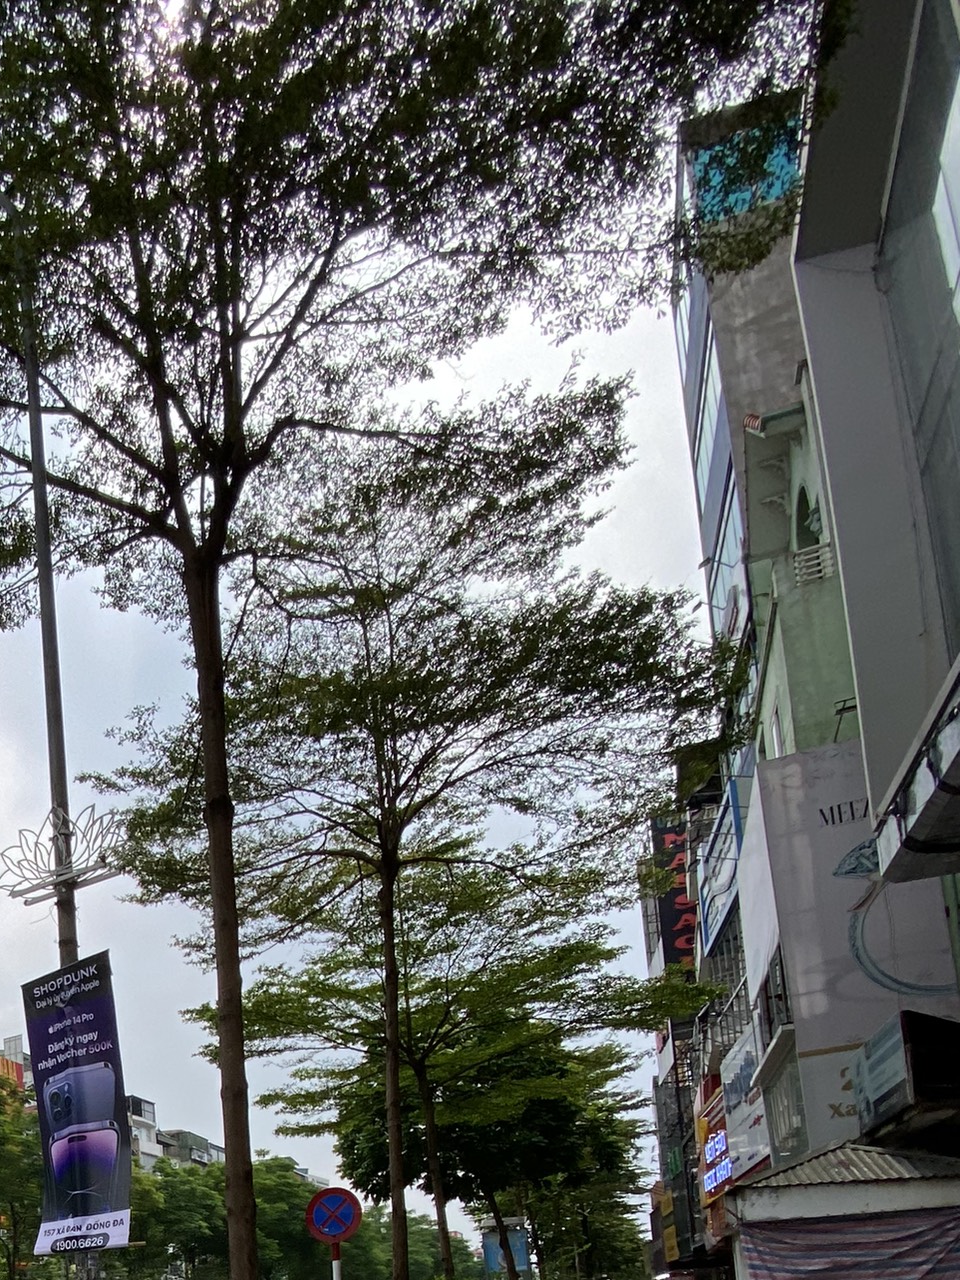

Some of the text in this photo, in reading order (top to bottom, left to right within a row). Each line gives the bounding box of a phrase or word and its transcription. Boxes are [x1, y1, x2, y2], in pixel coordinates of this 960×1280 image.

[33, 964, 98, 998] SHOPDUNK
[81, 979, 100, 992] Apple
[73, 1015, 81, 1025] 14
[82, 1013, 94, 1021] Pro
[76, 1031, 98, 1044] ngay
[57, 1046, 87, 1063] Voucher
[89, 1040, 113, 1054] 500K
[43, 1229, 56, 1237] 157
[56, 1236, 103, 1251] 1900.6626
